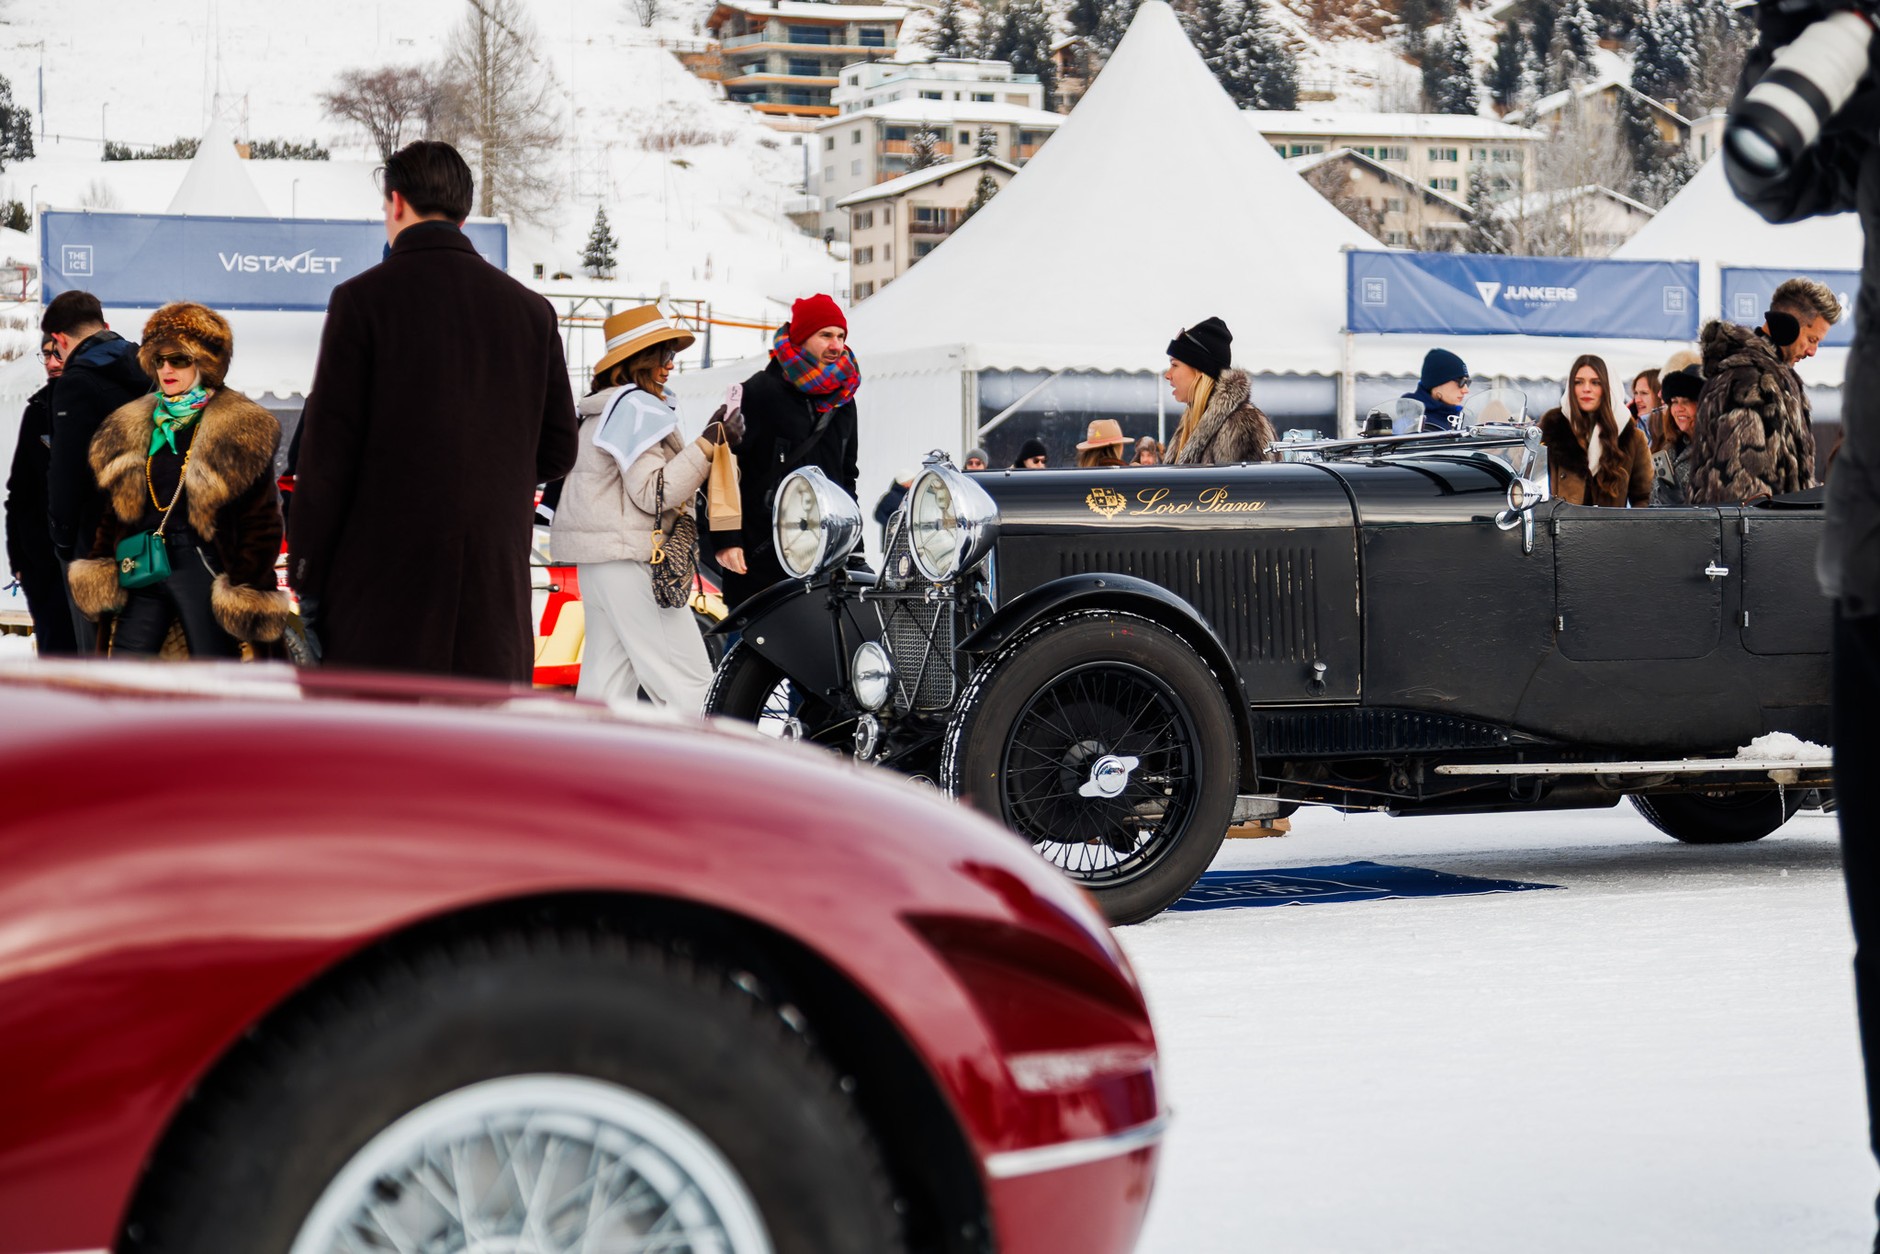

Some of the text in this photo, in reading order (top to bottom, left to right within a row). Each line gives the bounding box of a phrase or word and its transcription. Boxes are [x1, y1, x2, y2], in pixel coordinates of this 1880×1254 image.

[68, 251, 87, 260] THE
[218, 248, 342, 274] VISTAJET
[69, 260, 87, 270] ICE
[1503, 285, 1578, 302] JUNKERS
[1129, 484, 1266, 515] Loro Piana
